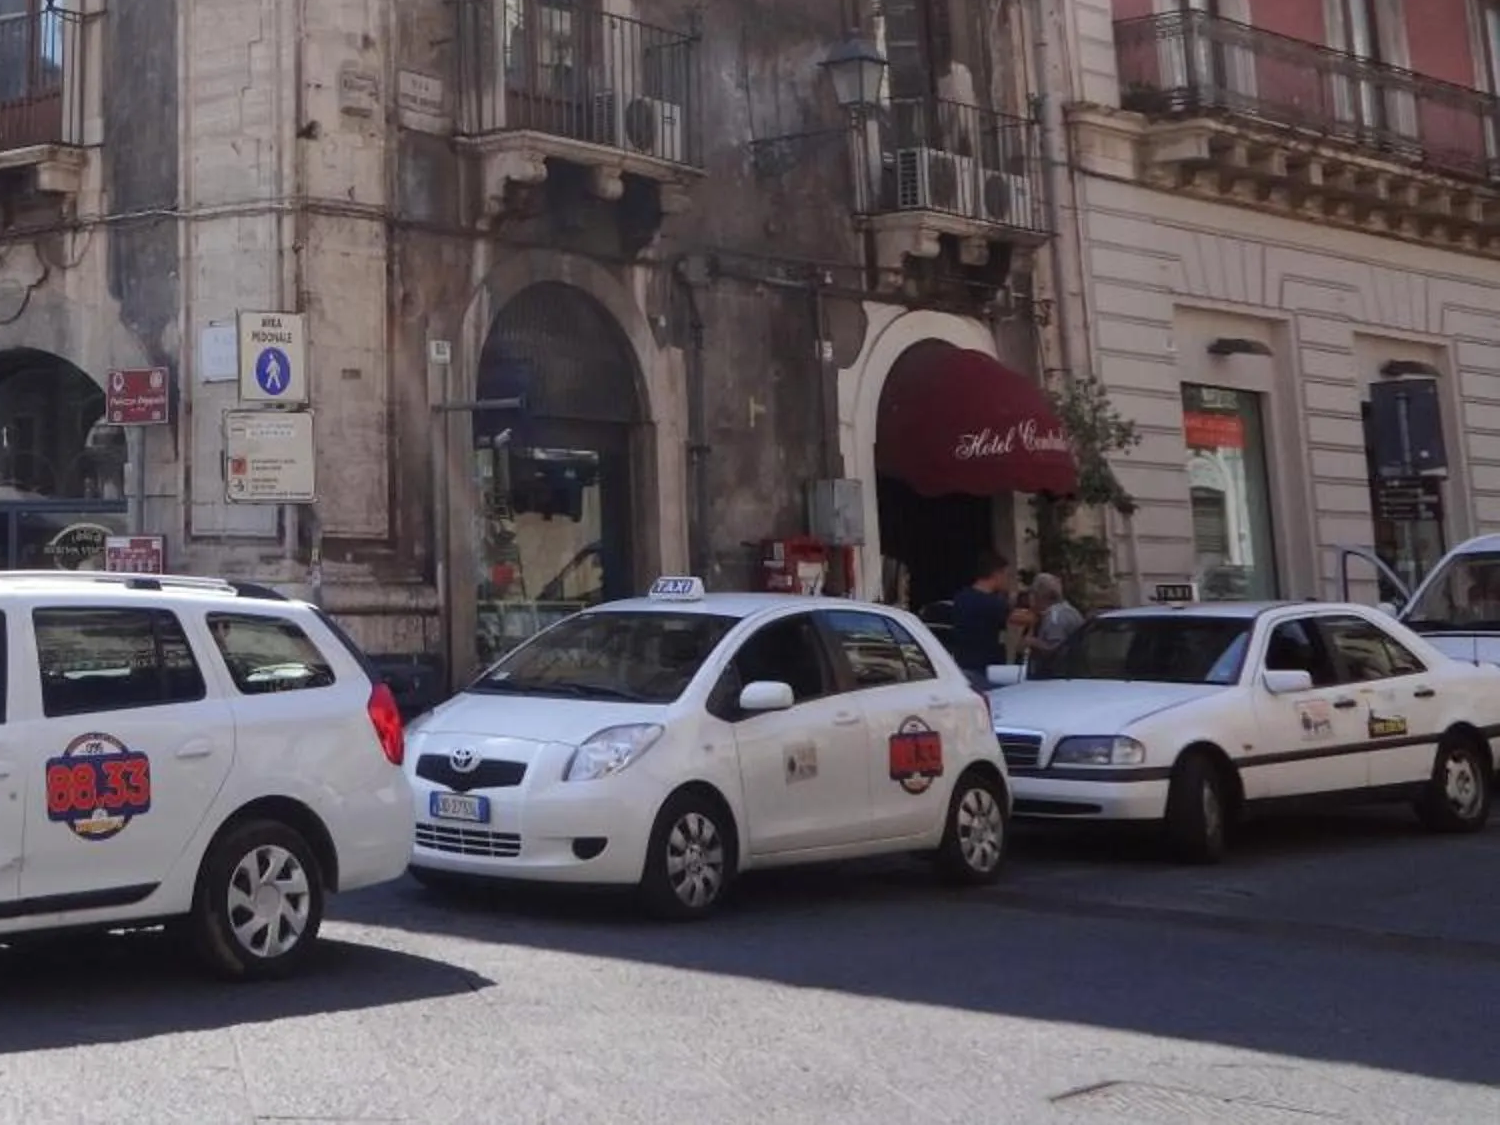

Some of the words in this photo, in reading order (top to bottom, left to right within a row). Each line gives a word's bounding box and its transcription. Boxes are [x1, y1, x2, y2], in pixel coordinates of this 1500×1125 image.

[261, 318, 283, 328] AREA
[251, 330, 293, 344] PEDONALE
[955, 426, 1016, 460] Hotel
[652, 579, 693, 594] TAXI
